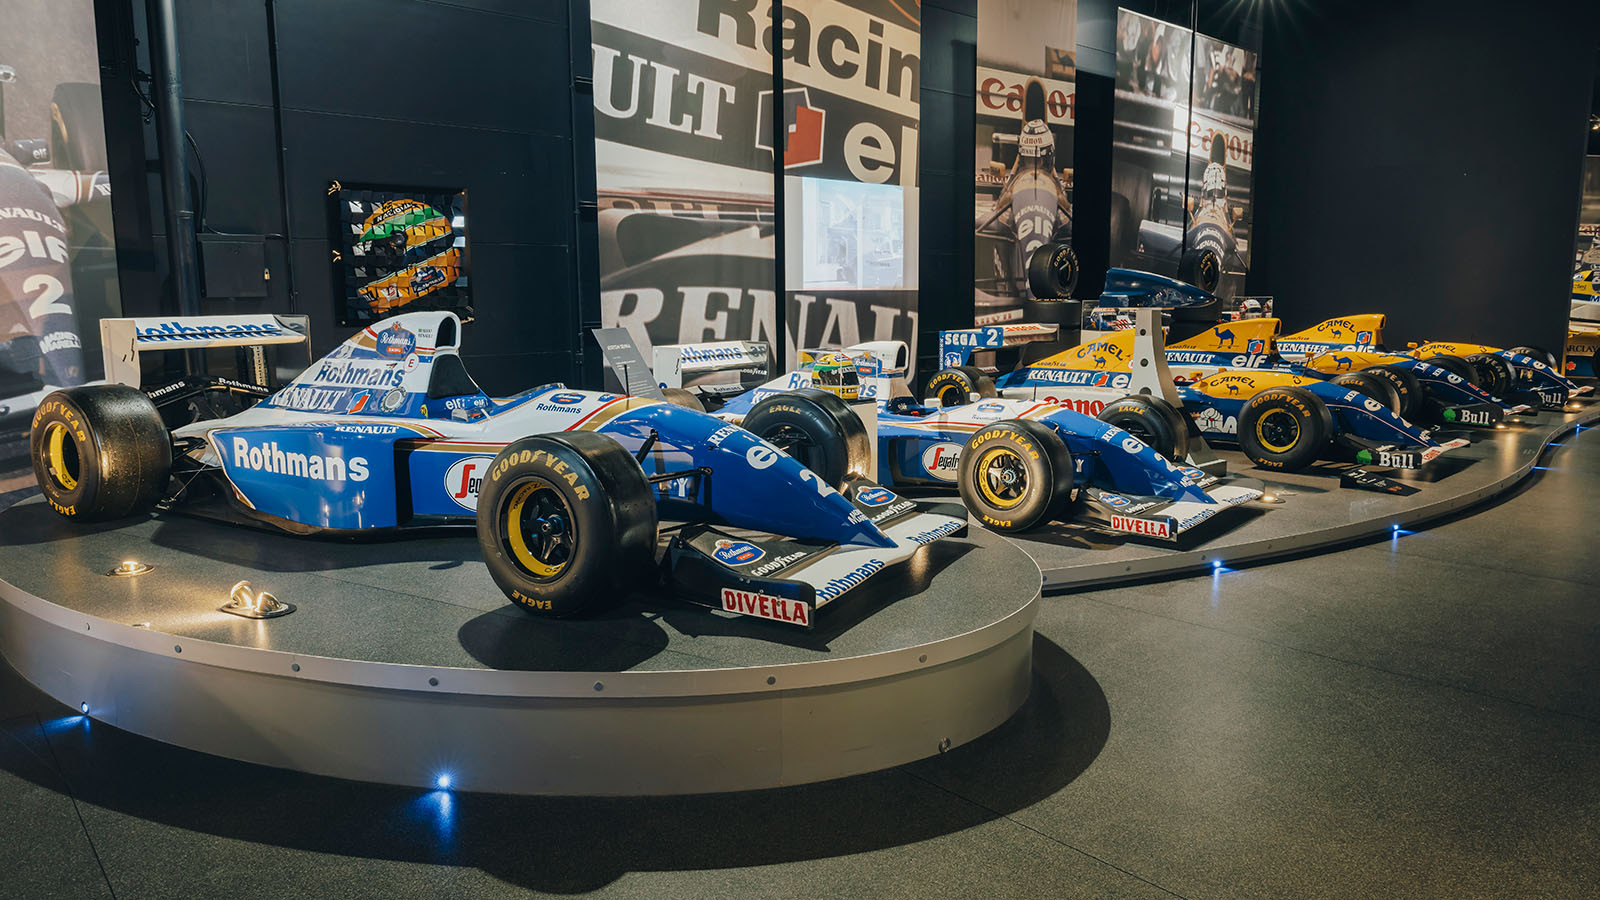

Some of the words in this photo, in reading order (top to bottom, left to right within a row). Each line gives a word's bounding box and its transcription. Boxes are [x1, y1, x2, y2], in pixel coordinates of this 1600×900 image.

[592, 43, 736, 140] ULT
[981, 77, 1075, 120] Cao
[23, 274, 73, 320] 2
[1317, 319, 1356, 333] CAMEL
[944, 333, 978, 346] SEGA
[986, 328, 998, 346] 2
[1076, 342, 1124, 361] CAMEL
[1421, 344, 1457, 354] CAMEL
[407, 358, 416, 368] E
[1231, 354, 1268, 368] elf
[314, 361, 406, 388] Rothmans
[1027, 367, 1092, 384] RENAULT
[1209, 375, 1256, 389] CAMEL
[218, 377, 270, 392] Rothmans
[269, 386, 348, 412] RENAULT
[535, 403, 583, 414] Rothmans
[769, 404, 801, 415] EAGLE
[1118, 405, 1146, 415] EAGLE
[1460, 409, 1490, 425] Bull
[335, 426, 400, 435] RENAULT
[232, 436, 370, 482] Rothmans
[1379, 451, 1415, 470] Bull
[800, 468, 838, 498] 2
[48, 497, 77, 515] EAGLE
[982, 514, 1012, 528] EAGLE
[1112, 516, 1168, 537] DIVELLA
[718, 544, 754, 560] Rothmans
[751, 551, 808, 577] GOODYEAR
[815, 556, 886, 602] Rothmans
[512, 589, 553, 611] EAGLE
[723, 590, 808, 625] DIVELLA
